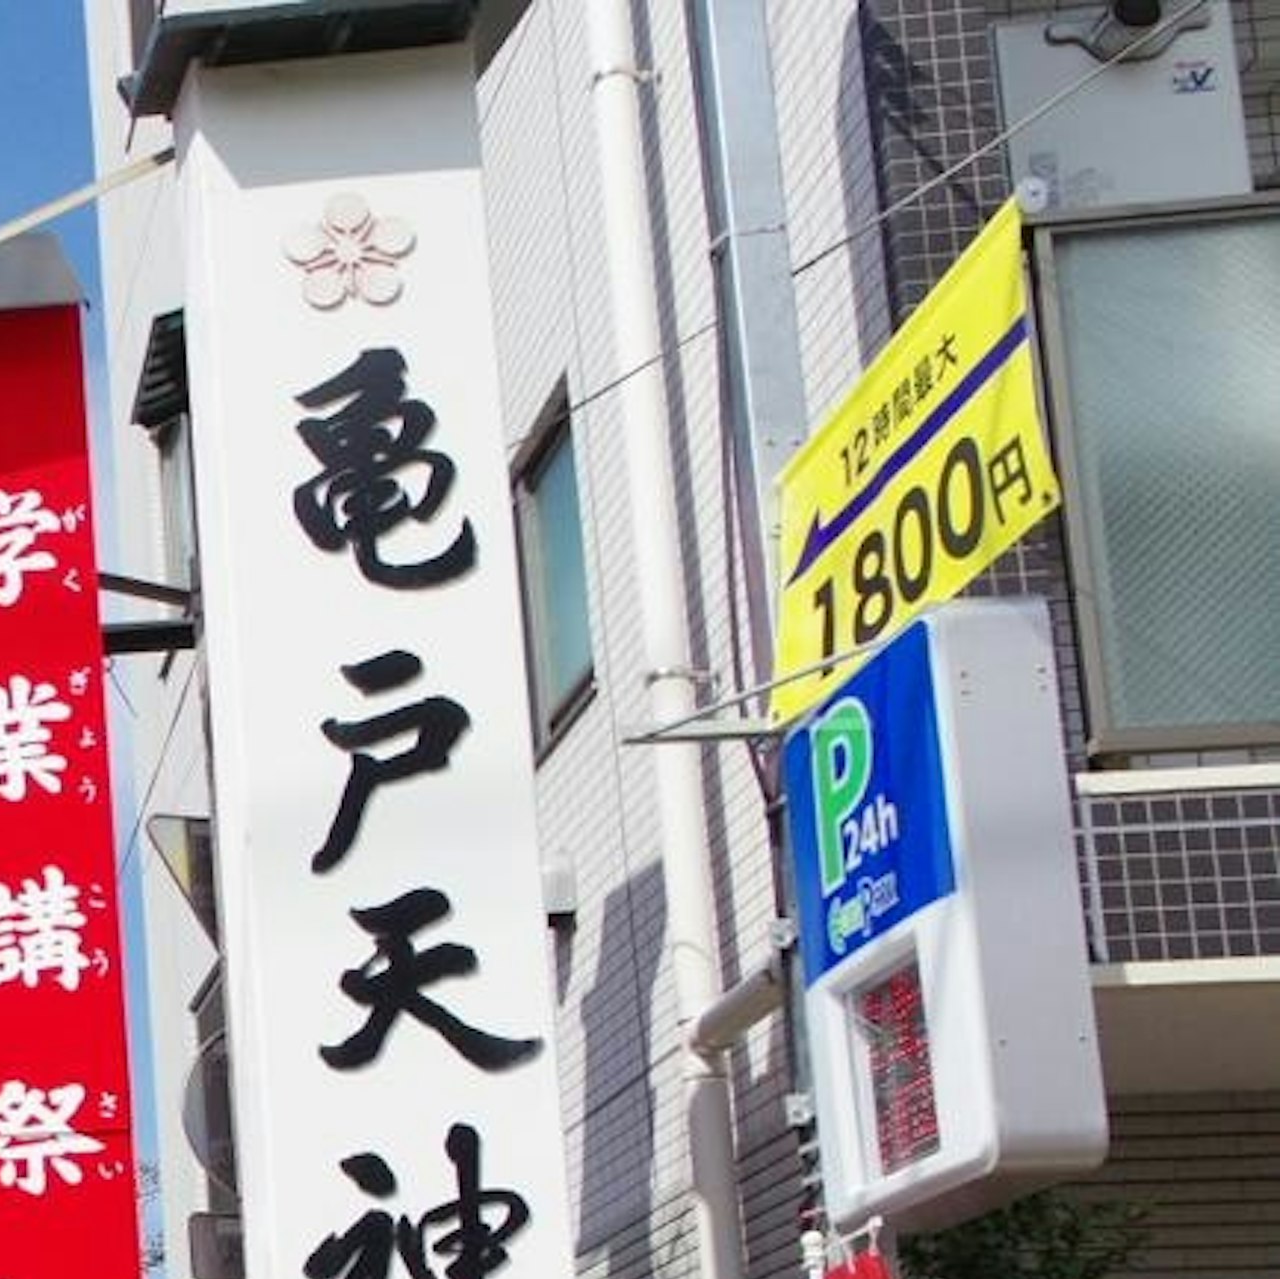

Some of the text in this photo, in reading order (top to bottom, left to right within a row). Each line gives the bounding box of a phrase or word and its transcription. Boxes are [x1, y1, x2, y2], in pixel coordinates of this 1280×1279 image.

[840, 333, 959, 486] 12時間最大
[813, 434, 1033, 680] 1800円
[810, 696, 872, 898] P
[843, 794, 899, 872] 24h
